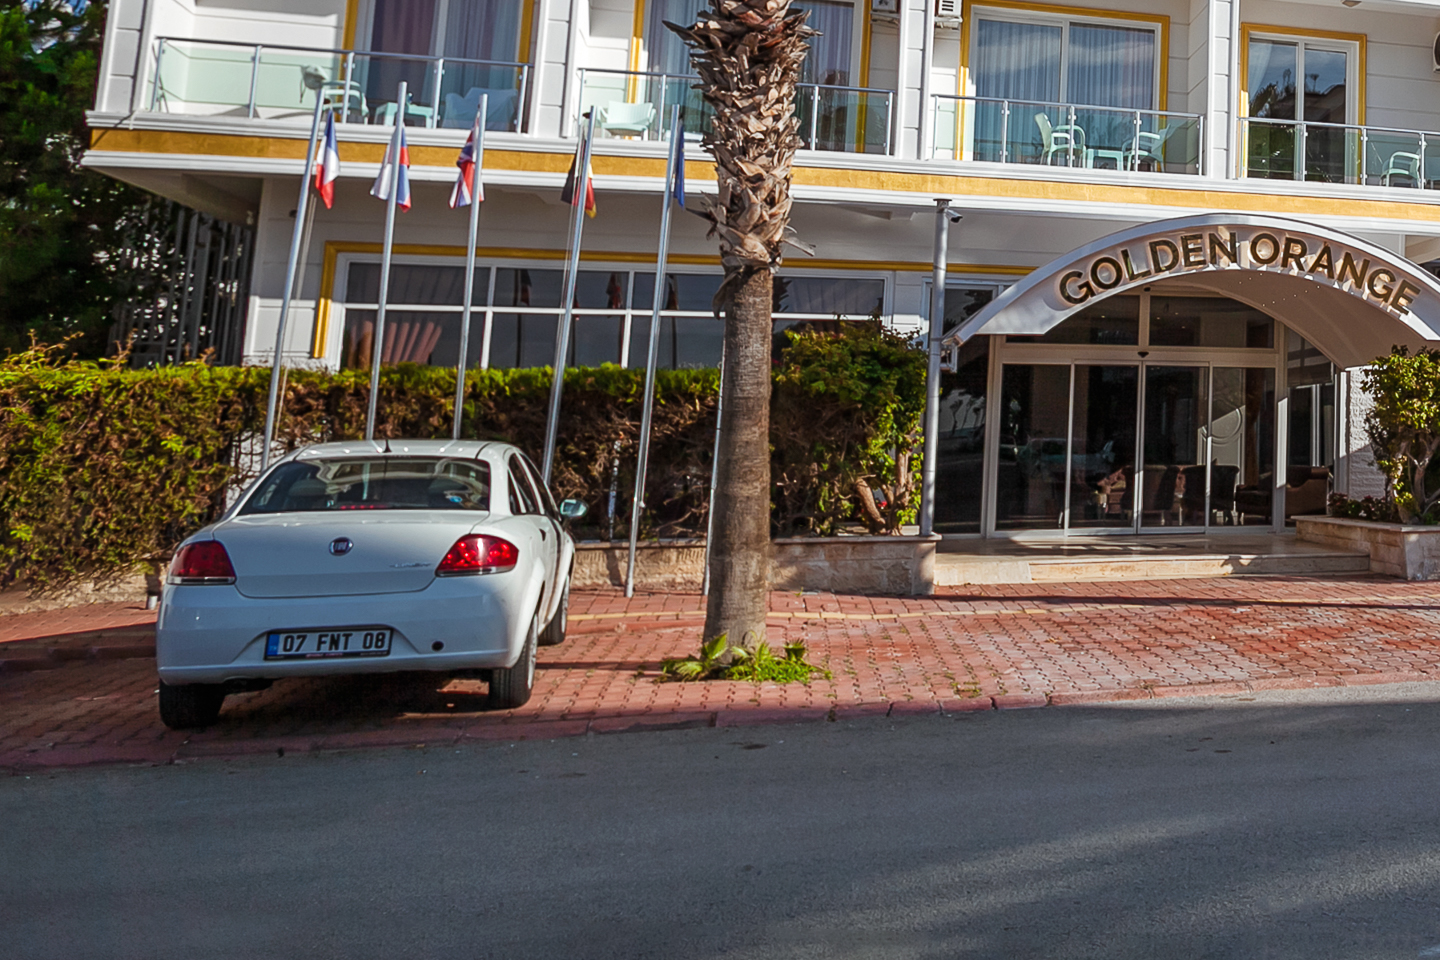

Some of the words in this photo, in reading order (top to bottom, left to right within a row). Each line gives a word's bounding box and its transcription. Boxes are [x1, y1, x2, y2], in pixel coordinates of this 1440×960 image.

[1059, 231, 1238, 306] GOLDEN
[1250, 231, 1422, 316] ORANGE
[282, 634, 308, 653] 07
[316, 632, 354, 652] FNT
[362, 632, 387, 650] 08
